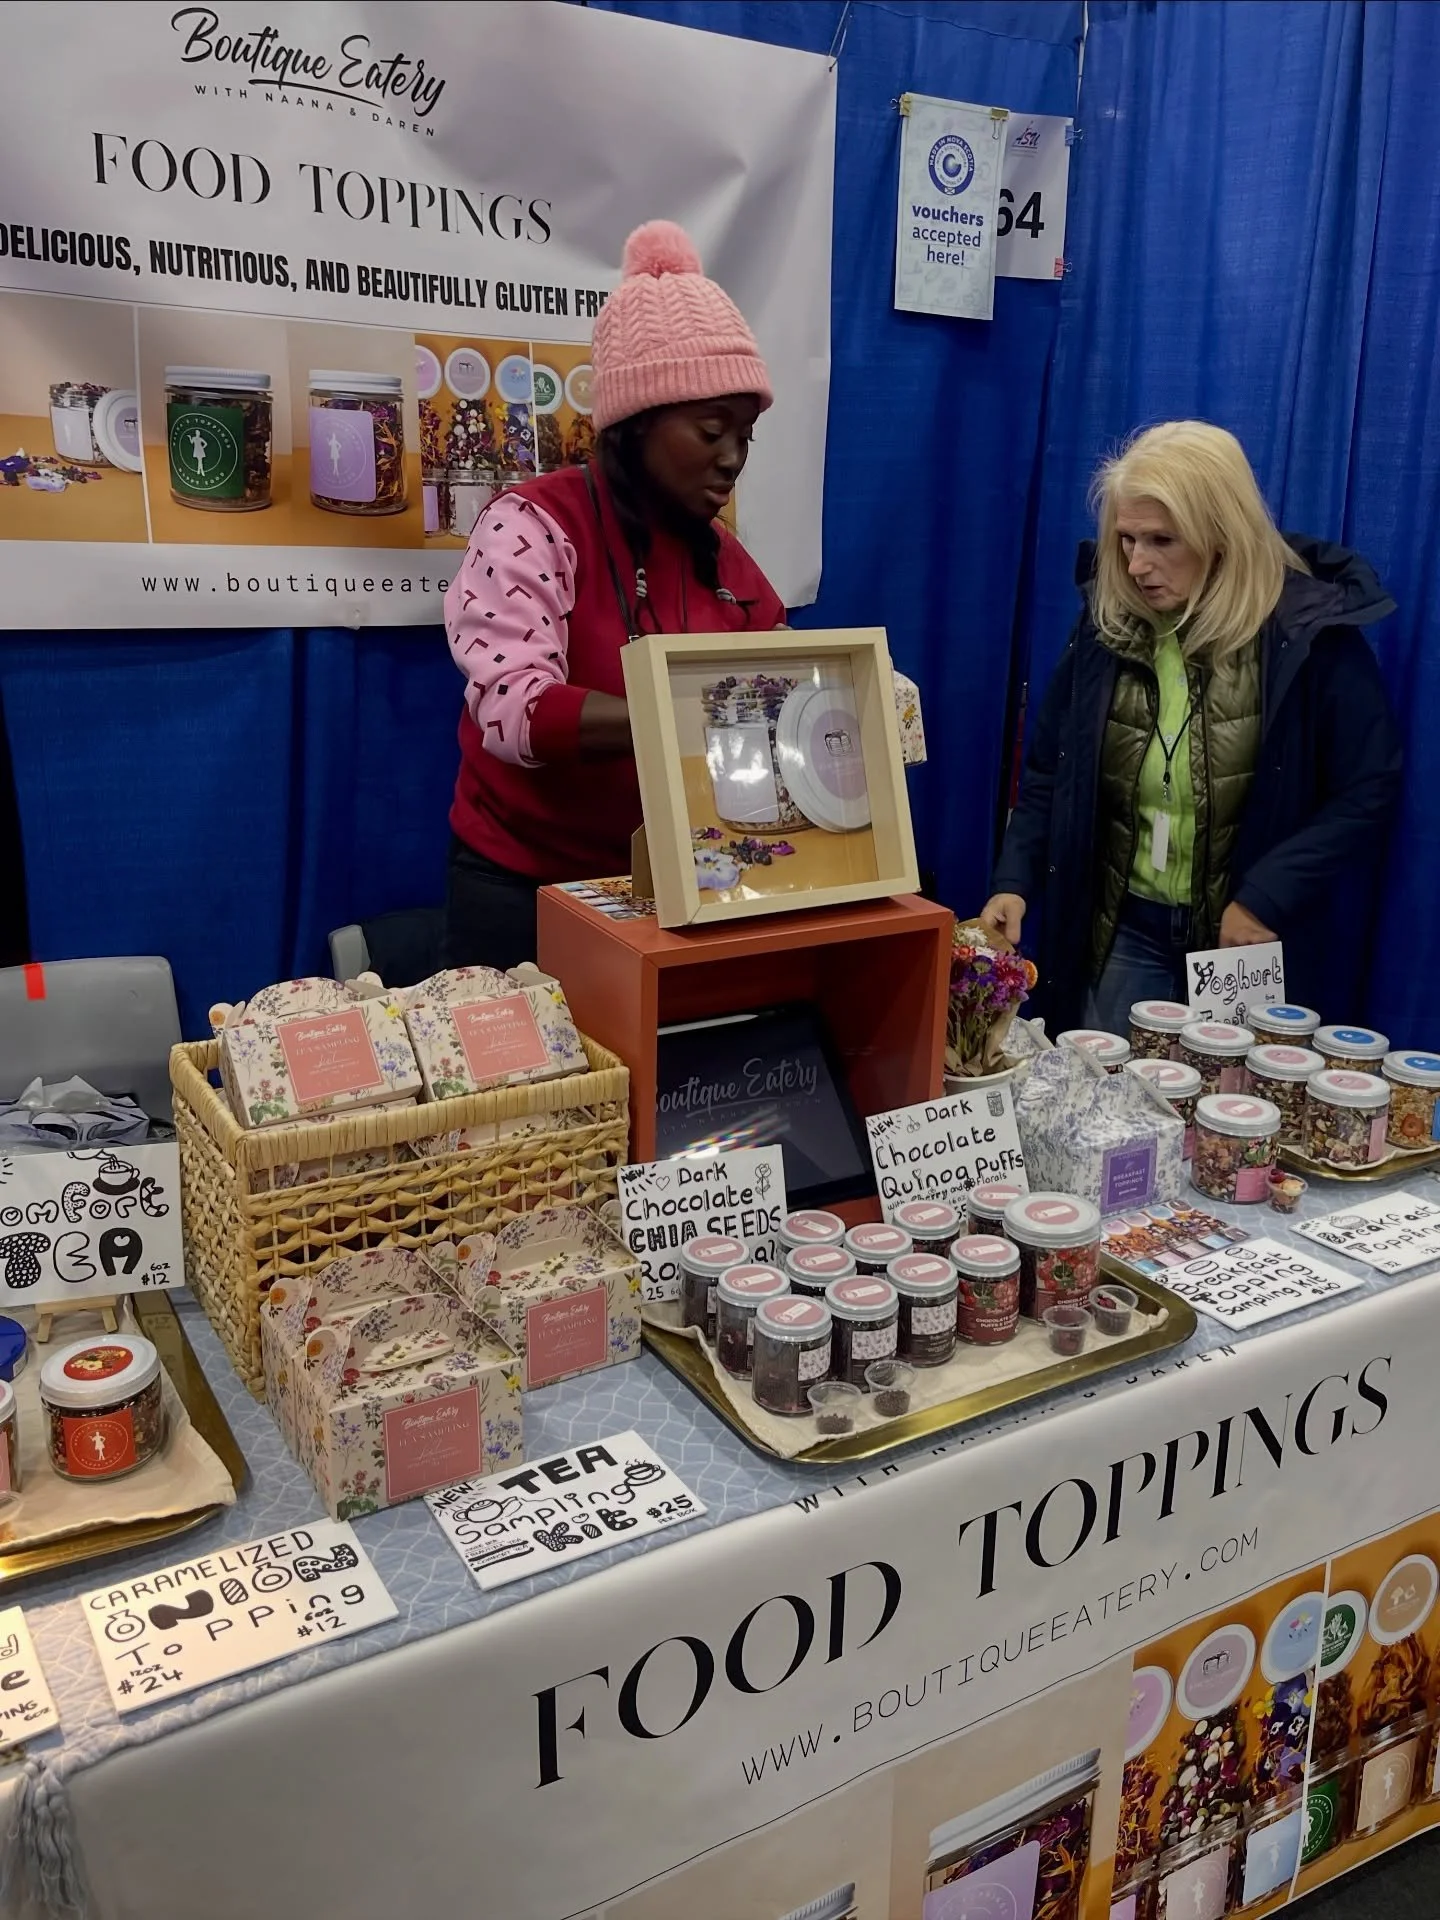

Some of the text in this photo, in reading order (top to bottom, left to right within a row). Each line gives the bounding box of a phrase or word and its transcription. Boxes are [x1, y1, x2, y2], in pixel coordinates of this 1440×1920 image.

[171, 7, 446, 117] Boutique Eatery
[195, 85, 435, 137] WITH NAANA & DAREN
[930, 136, 974, 172] MADE IN NOVA SCOTIA
[92, 132, 551, 245] FOOD TOPPINGS
[912, 204, 984, 227] vouchers
[912, 226, 981, 248] accepted
[927, 245, 965, 266] here!
[0, 223, 612, 318] DELICIOUS, NUTRITIOUS, AND BEAUTIFULLY GLUTEN FRE
[141, 573, 450, 597] www.boutiqueeate
[1193, 955, 1283, 1006] Yoghurt
[655, 1057, 818, 1118] outique Eatery
[871, 1099, 973, 1139] NEW Dark
[876, 1126, 996, 1170] Chocolate
[621, 1161, 728, 1187] NEW Dark
[881, 1149, 1024, 1200] Quinoa Puffs
[950, 1183, 963, 1194] and
[977, 1172, 1008, 1185] Florals
[626, 1184, 753, 1220] Chocolate
[629, 1220, 699, 1254] CHIA
[0, 1227, 143, 1289] TEA
[1216, 1285, 1303, 1316] Sampling
[433, 1481, 475, 1510] NEW
[500, 1444, 618, 1495] TEA
[455, 1484, 635, 1545] Sampling
[646, 1494, 693, 1520] $25
[657, 1507, 698, 1526] PER BOX
[89, 1530, 314, 1611] CARAMELIZED
[531, 1356, 1394, 1789] FOOD TOPPINGS
[304, 1607, 334, 1621] 6oz
[129, 1663, 164, 1677] 12oz
[742, 1526, 1260, 1787] WWW.BOUTIQUEEATERY.COM
